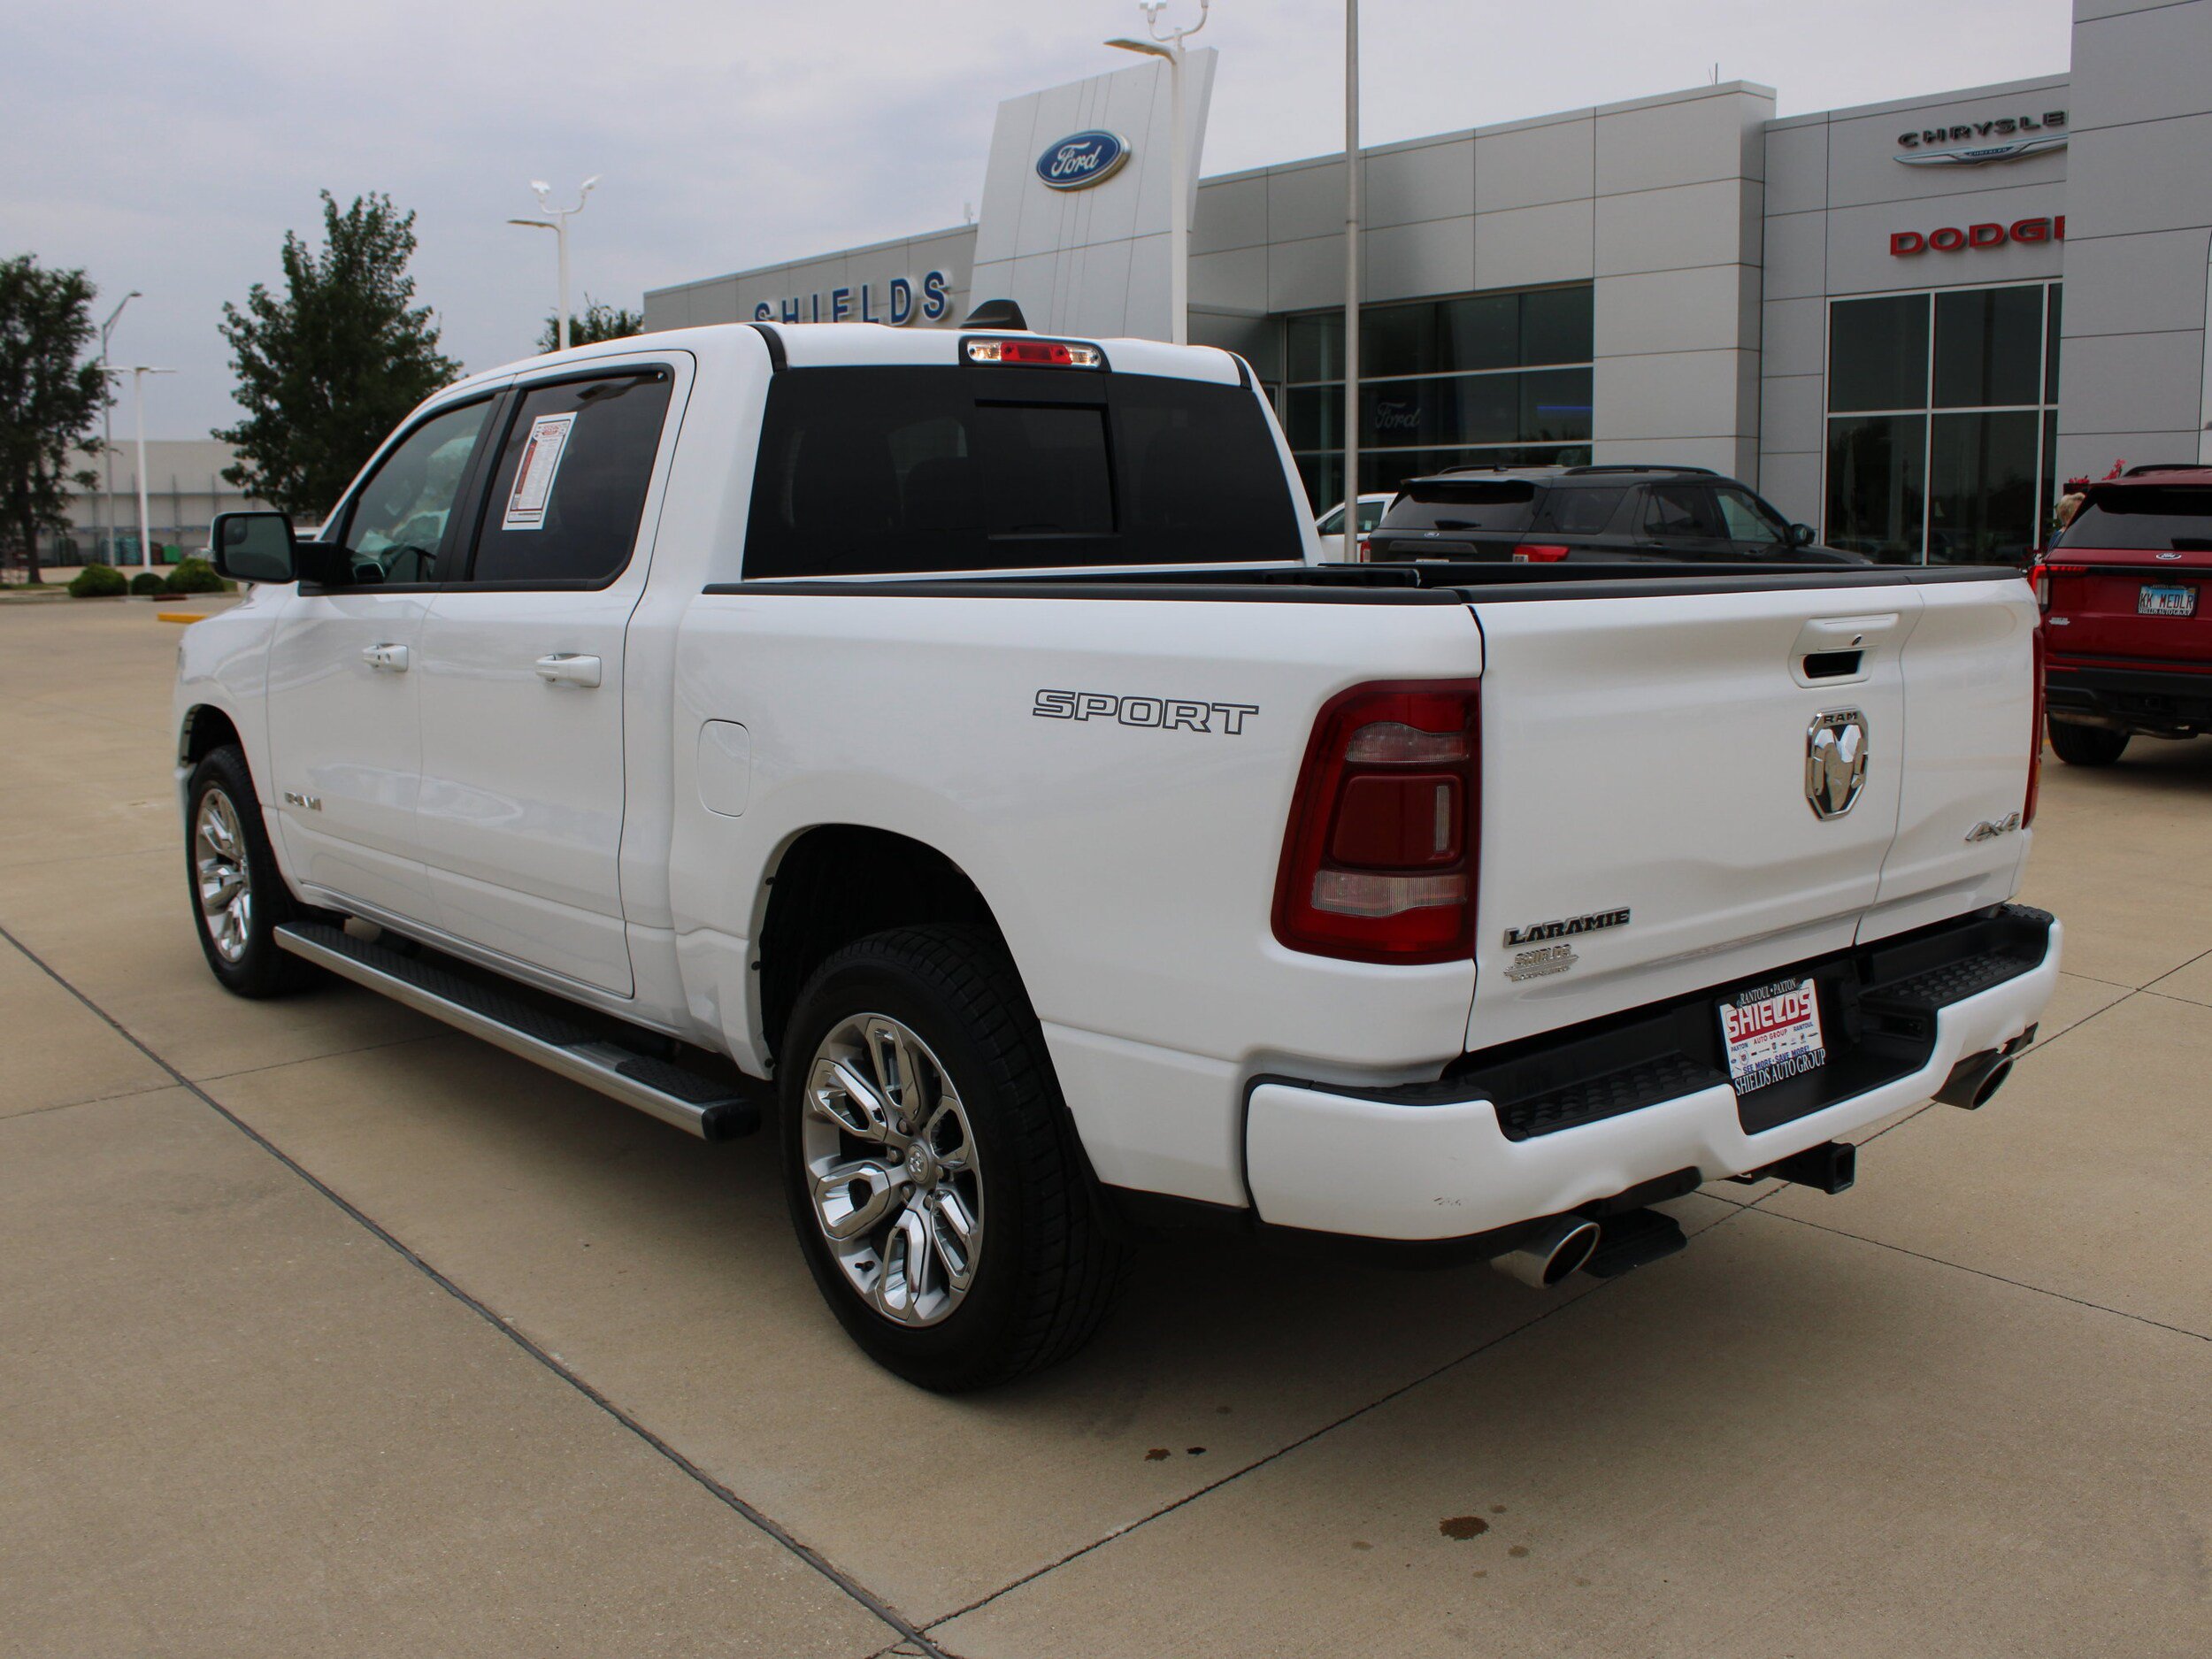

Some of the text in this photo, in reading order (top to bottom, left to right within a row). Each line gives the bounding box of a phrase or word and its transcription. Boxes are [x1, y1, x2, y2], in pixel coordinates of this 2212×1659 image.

[1897, 110, 2067, 148] CHRYSLE
[1051, 142, 1102, 177] Ford
[754, 270, 949, 326] SHIELDS
[1375, 402, 1421, 429] Ford
[1033, 688, 1259, 735] SPORT
[1824, 711, 1858, 724] RAM
[1503, 906, 1631, 948] LARAMIE
[1772, 978, 1796, 995] PAXTON
[1725, 988, 1811, 1037] SHIELDS
[1754, 1029, 1787, 1045] AUTO GROUP
[1734, 1067, 1771, 1096] SHIELDS
[1771, 1059, 1796, 1083] AUTO
[1796, 1048, 1826, 1073] GROUP
